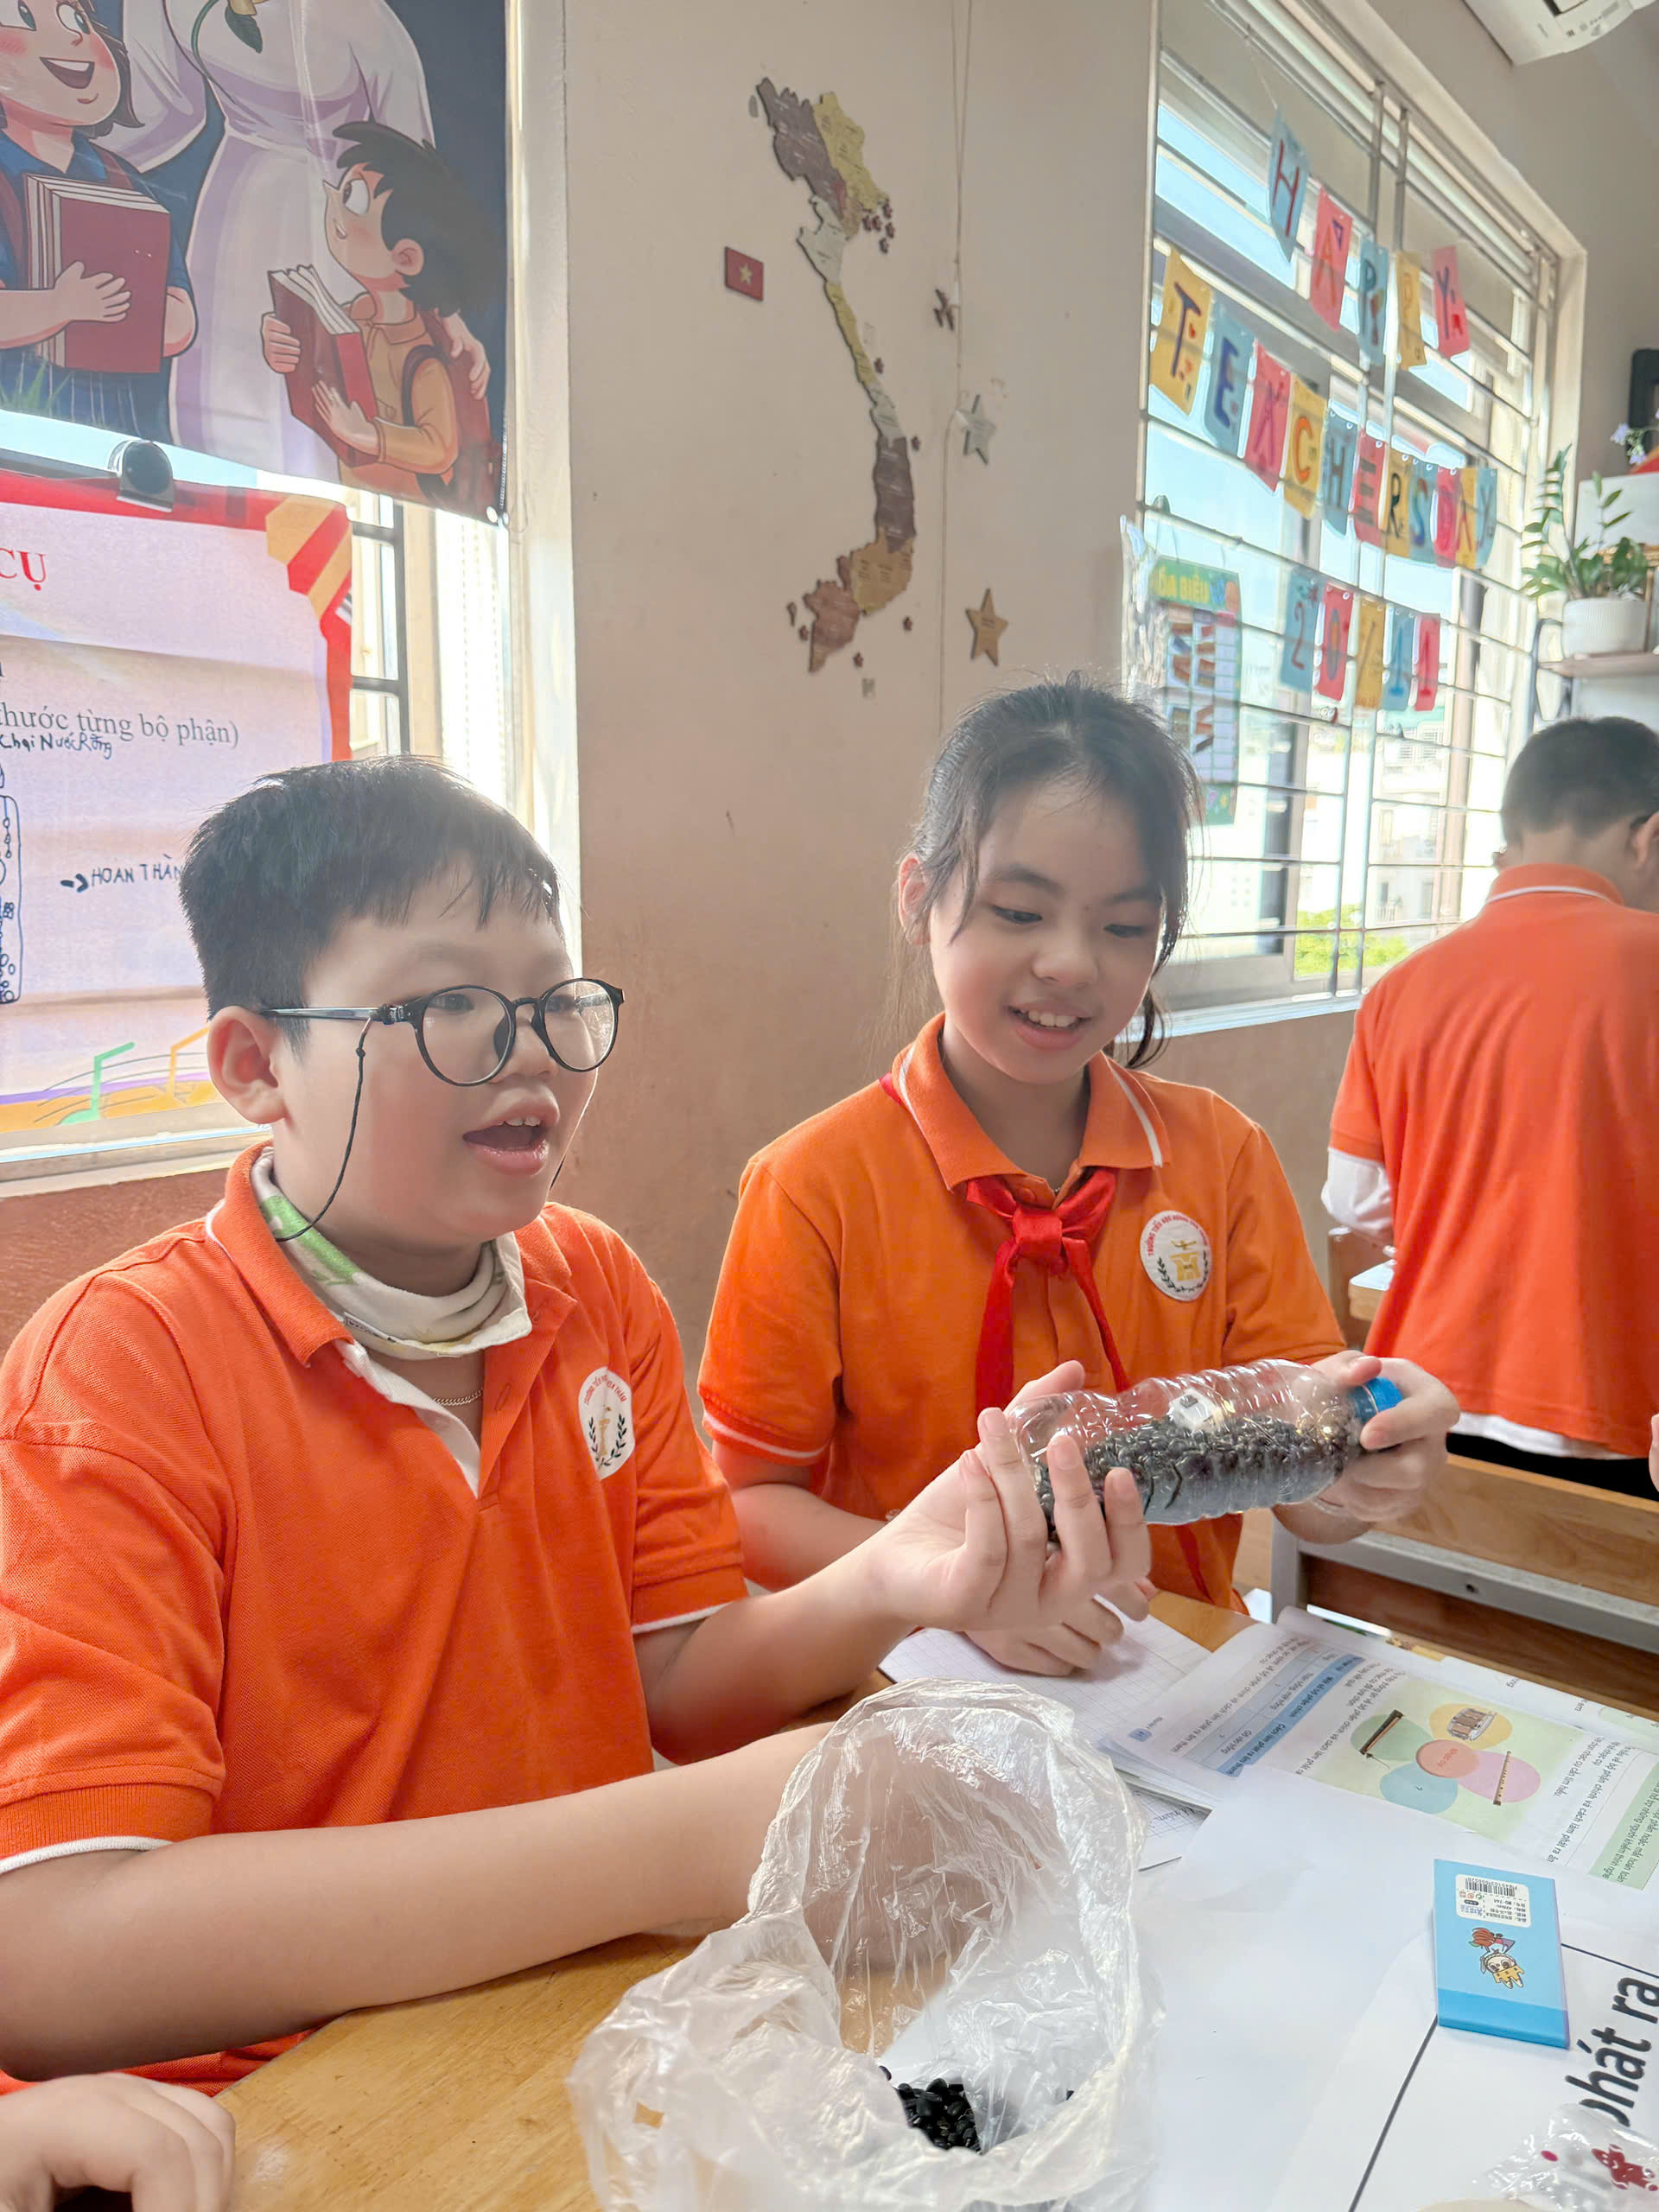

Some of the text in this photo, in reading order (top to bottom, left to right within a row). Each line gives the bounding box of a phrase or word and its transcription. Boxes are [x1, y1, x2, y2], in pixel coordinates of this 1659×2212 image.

[76, 709, 134, 741] từng
[138, 713, 169, 742] bộ
[175, 717, 239, 749] phận)
[139, 853, 183, 881] THÀN
[1573, 1808, 1586, 1821] cách
[1566, 1822, 1580, 1834] làm
[1556, 1833, 1569, 1847] phát
[1611, 1977, 1659, 2024] ra
